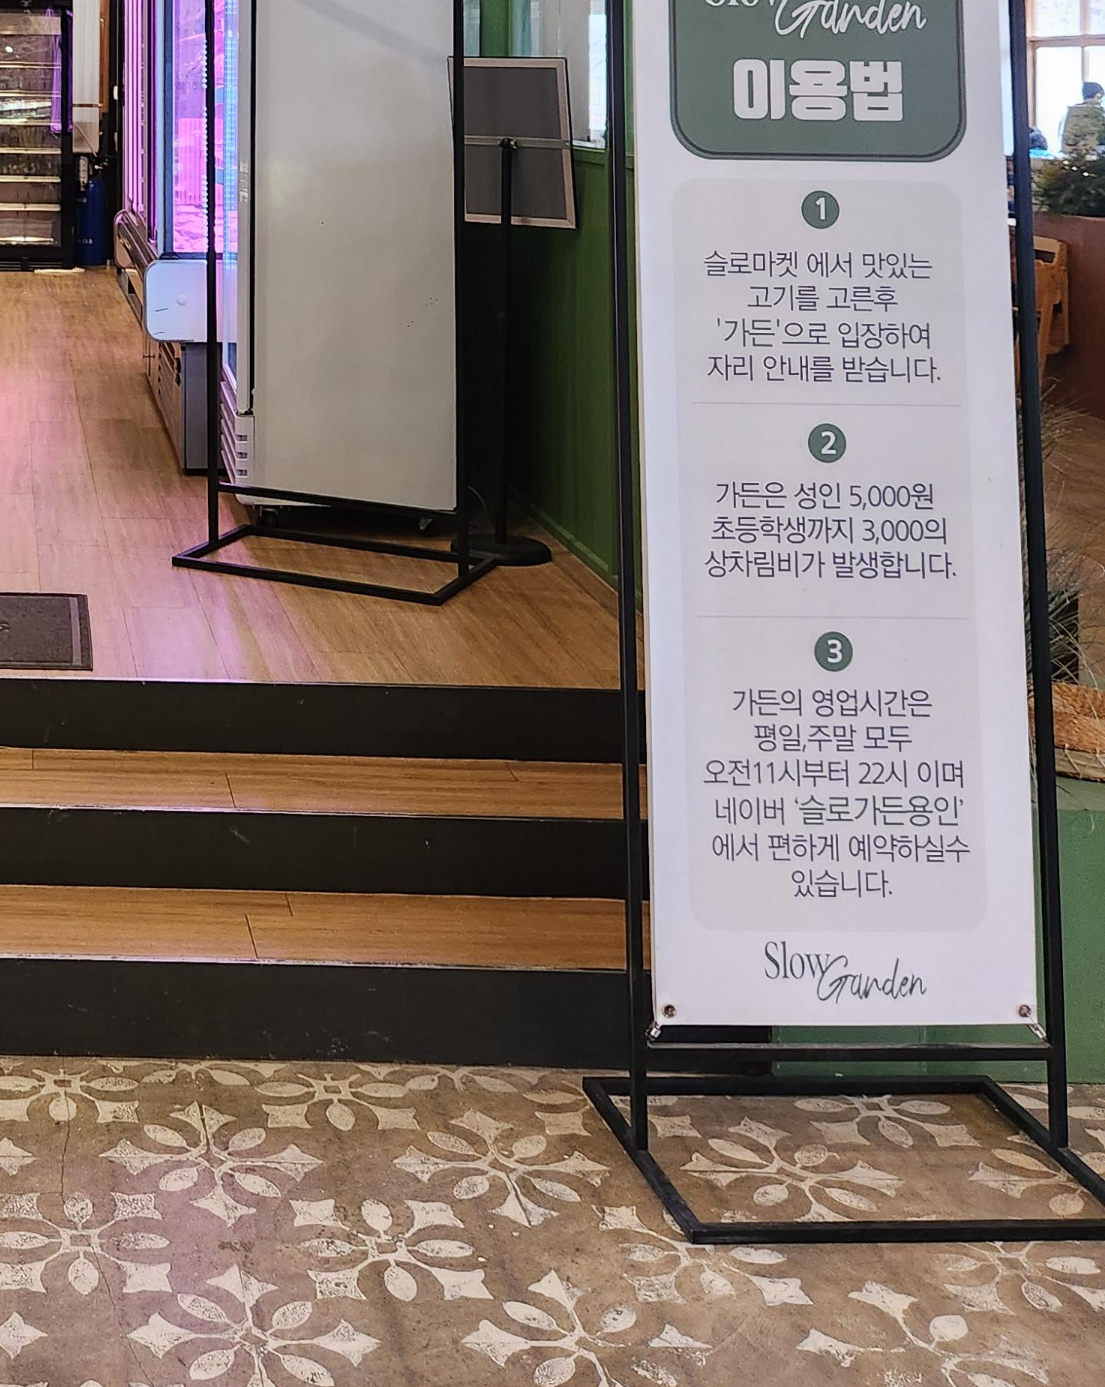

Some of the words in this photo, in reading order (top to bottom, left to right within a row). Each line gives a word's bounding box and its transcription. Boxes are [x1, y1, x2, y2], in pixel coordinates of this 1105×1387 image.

[733, 58, 903, 122] 이용법
[815, 198, 825, 219] 1
[704, 250, 797, 277] 슬로마켓
[807, 252, 852, 278] 에서
[862, 253, 932, 279] 맛있는
[748, 285, 819, 311] 고기를
[826, 286, 898, 312] 고른후
[838, 322, 930, 349] 입장하여
[708, 354, 753, 381] 자리
[764, 355, 834, 382] 안내를
[843, 356, 940, 383] 받습니다.
[821, 432, 837, 455] 2
[717, 481, 787, 508] 가든은
[794, 482, 840, 510] 성인
[850, 483, 933, 510] 5,000원
[711, 516, 853, 544] 초등학생까지
[705, 550, 825, 578] 상차림비가
[833, 551, 956, 579] 발생합니다.
[827, 640, 842, 662] 3
[733, 688, 802, 716] 가든의
[812, 689, 932, 717] 영업시간은
[754, 724, 857, 752] 평일,주말
[863, 726, 912, 752] 모두
[704, 759, 849, 787] 오전11시부터
[859, 760, 907, 787] 22시
[918, 760, 963, 788] 이며
[716, 797, 785, 825] 네이버
[713, 833, 758, 861] 에서
[768, 834, 839, 862] 편하게
[849, 834, 970, 863] 예약하실수
[792, 869, 892, 898] 있습니다.
[764, 941, 830, 979] Slow
[817, 955, 927, 1003] Garden
